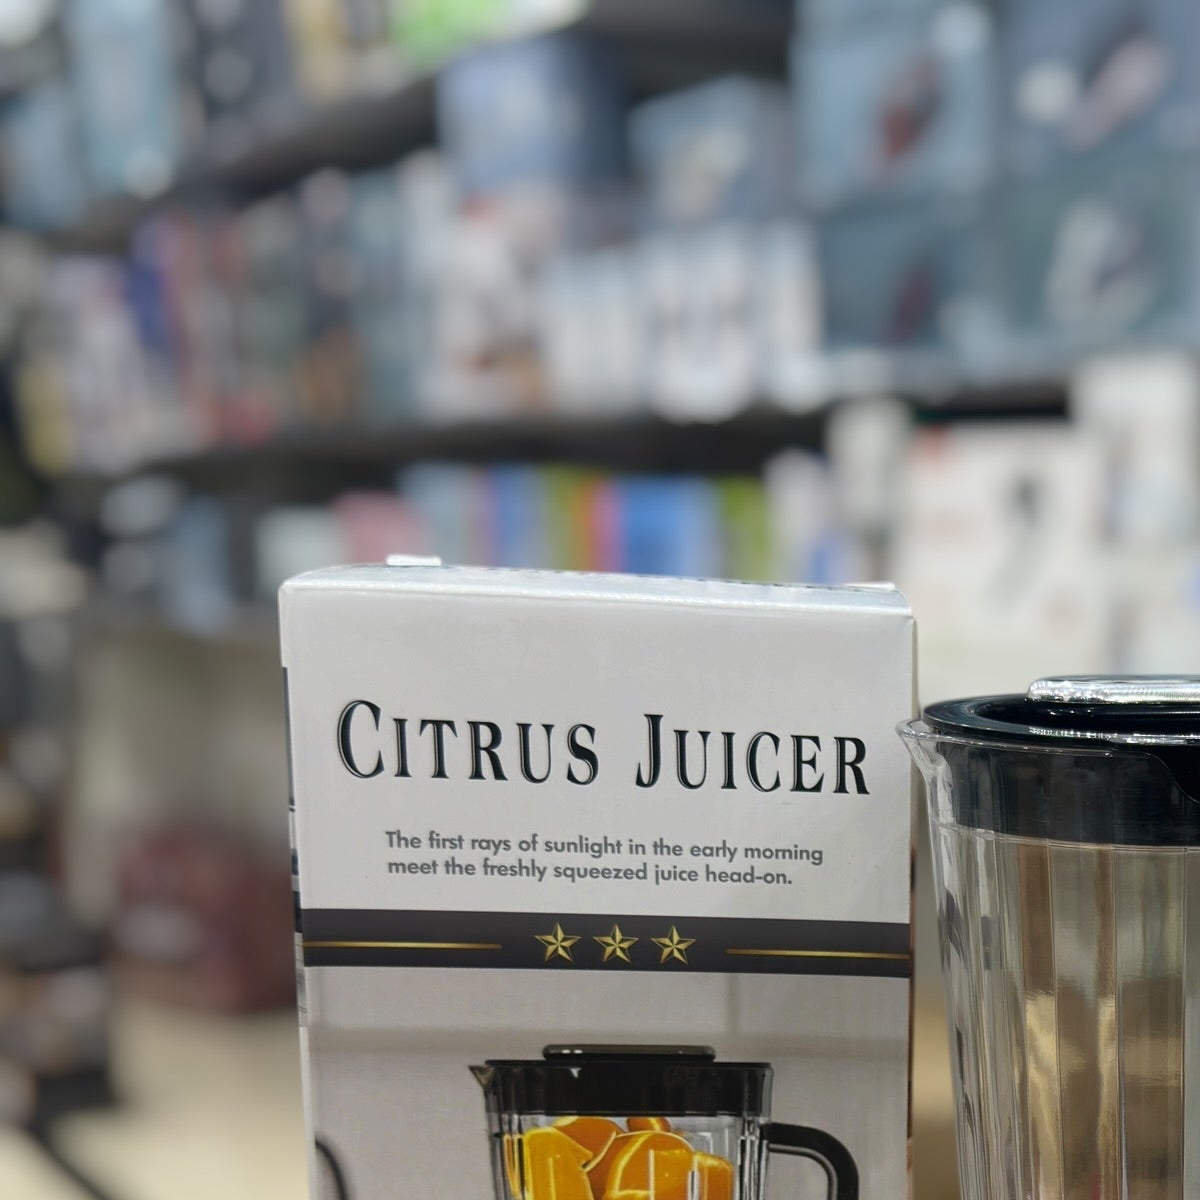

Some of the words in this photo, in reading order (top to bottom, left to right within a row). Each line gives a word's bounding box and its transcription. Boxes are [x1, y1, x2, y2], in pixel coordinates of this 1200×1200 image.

[384, 828, 423, 849] The
[428, 830, 465, 850] first
[471, 836, 512, 857] rays
[518, 832, 539, 853] of
[543, 834, 624, 860] sunlight
[628, 838, 647, 856] in
[652, 836, 684, 857] the
[690, 839, 739, 864] early
[743, 843, 825, 867] morning
[387, 858, 439, 875] meet
[444, 855, 477, 876] the
[482, 856, 548, 883] freshly
[552, 861, 648, 884] squeezed
[654, 863, 700, 886] juice
[704, 863, 794, 886] head-on.
